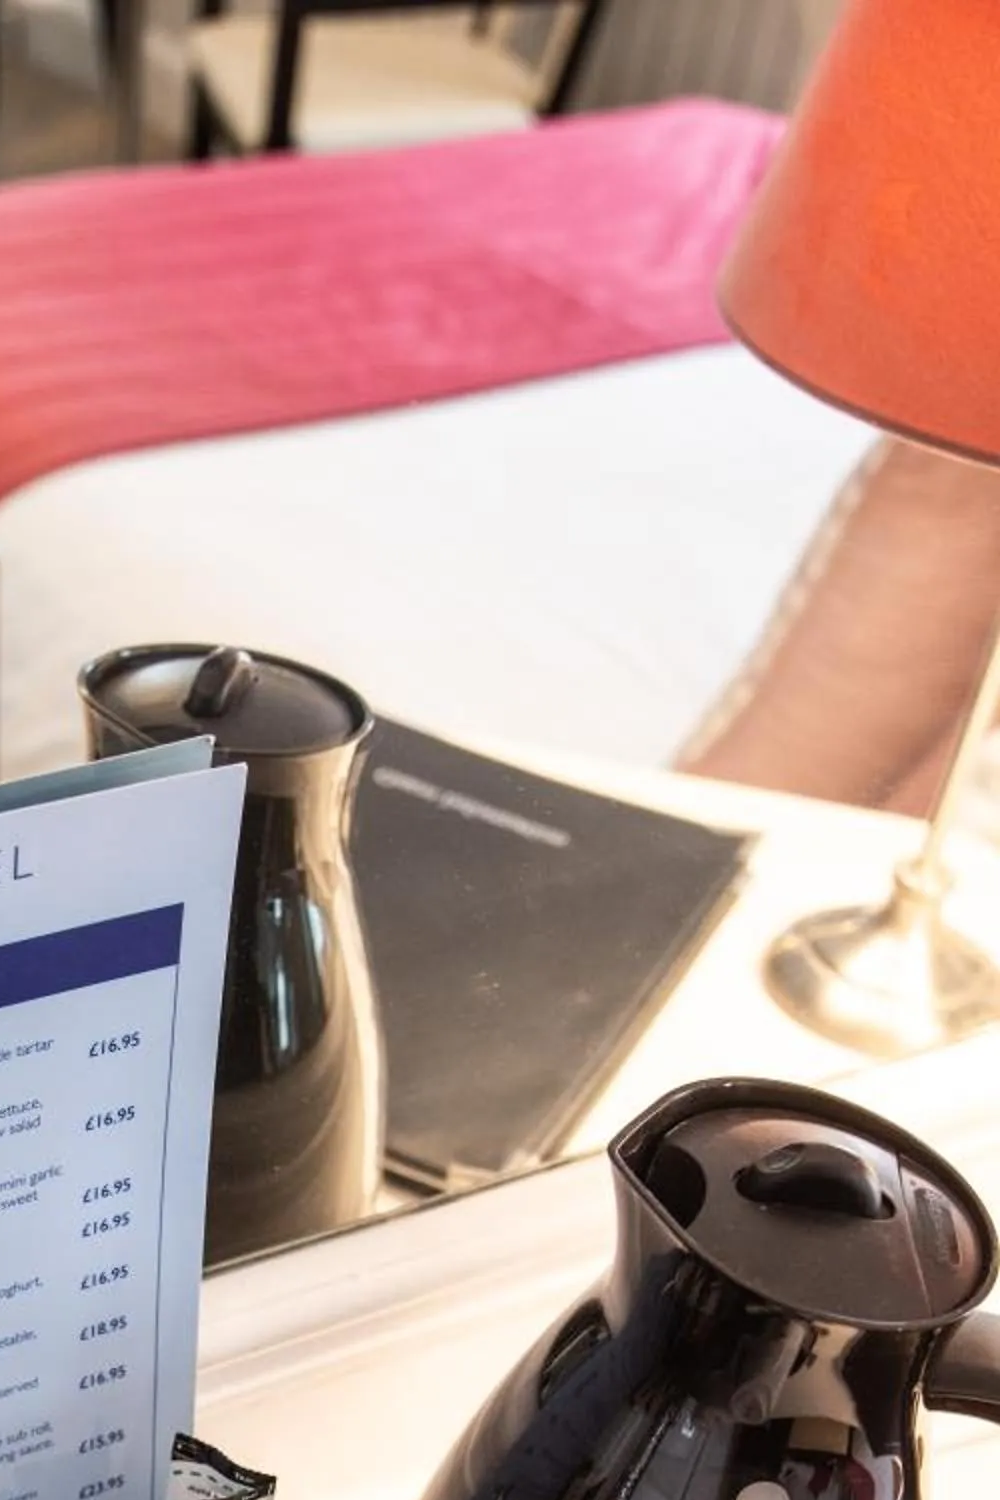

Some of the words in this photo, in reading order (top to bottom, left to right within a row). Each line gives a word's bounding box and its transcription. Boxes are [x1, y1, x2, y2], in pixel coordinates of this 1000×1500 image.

[88, 1031, 140, 1057] £16.95
[8, 1113, 41, 1134] salad
[84, 1105, 135, 1131] £16.95
[0, 1189, 38, 1210] sweet
[82, 1177, 131, 1203] £16.95
[81, 1211, 130, 1238] £16.95
[80, 1263, 128, 1290] £16.95
[78, 1364, 126, 1389] £16.95
